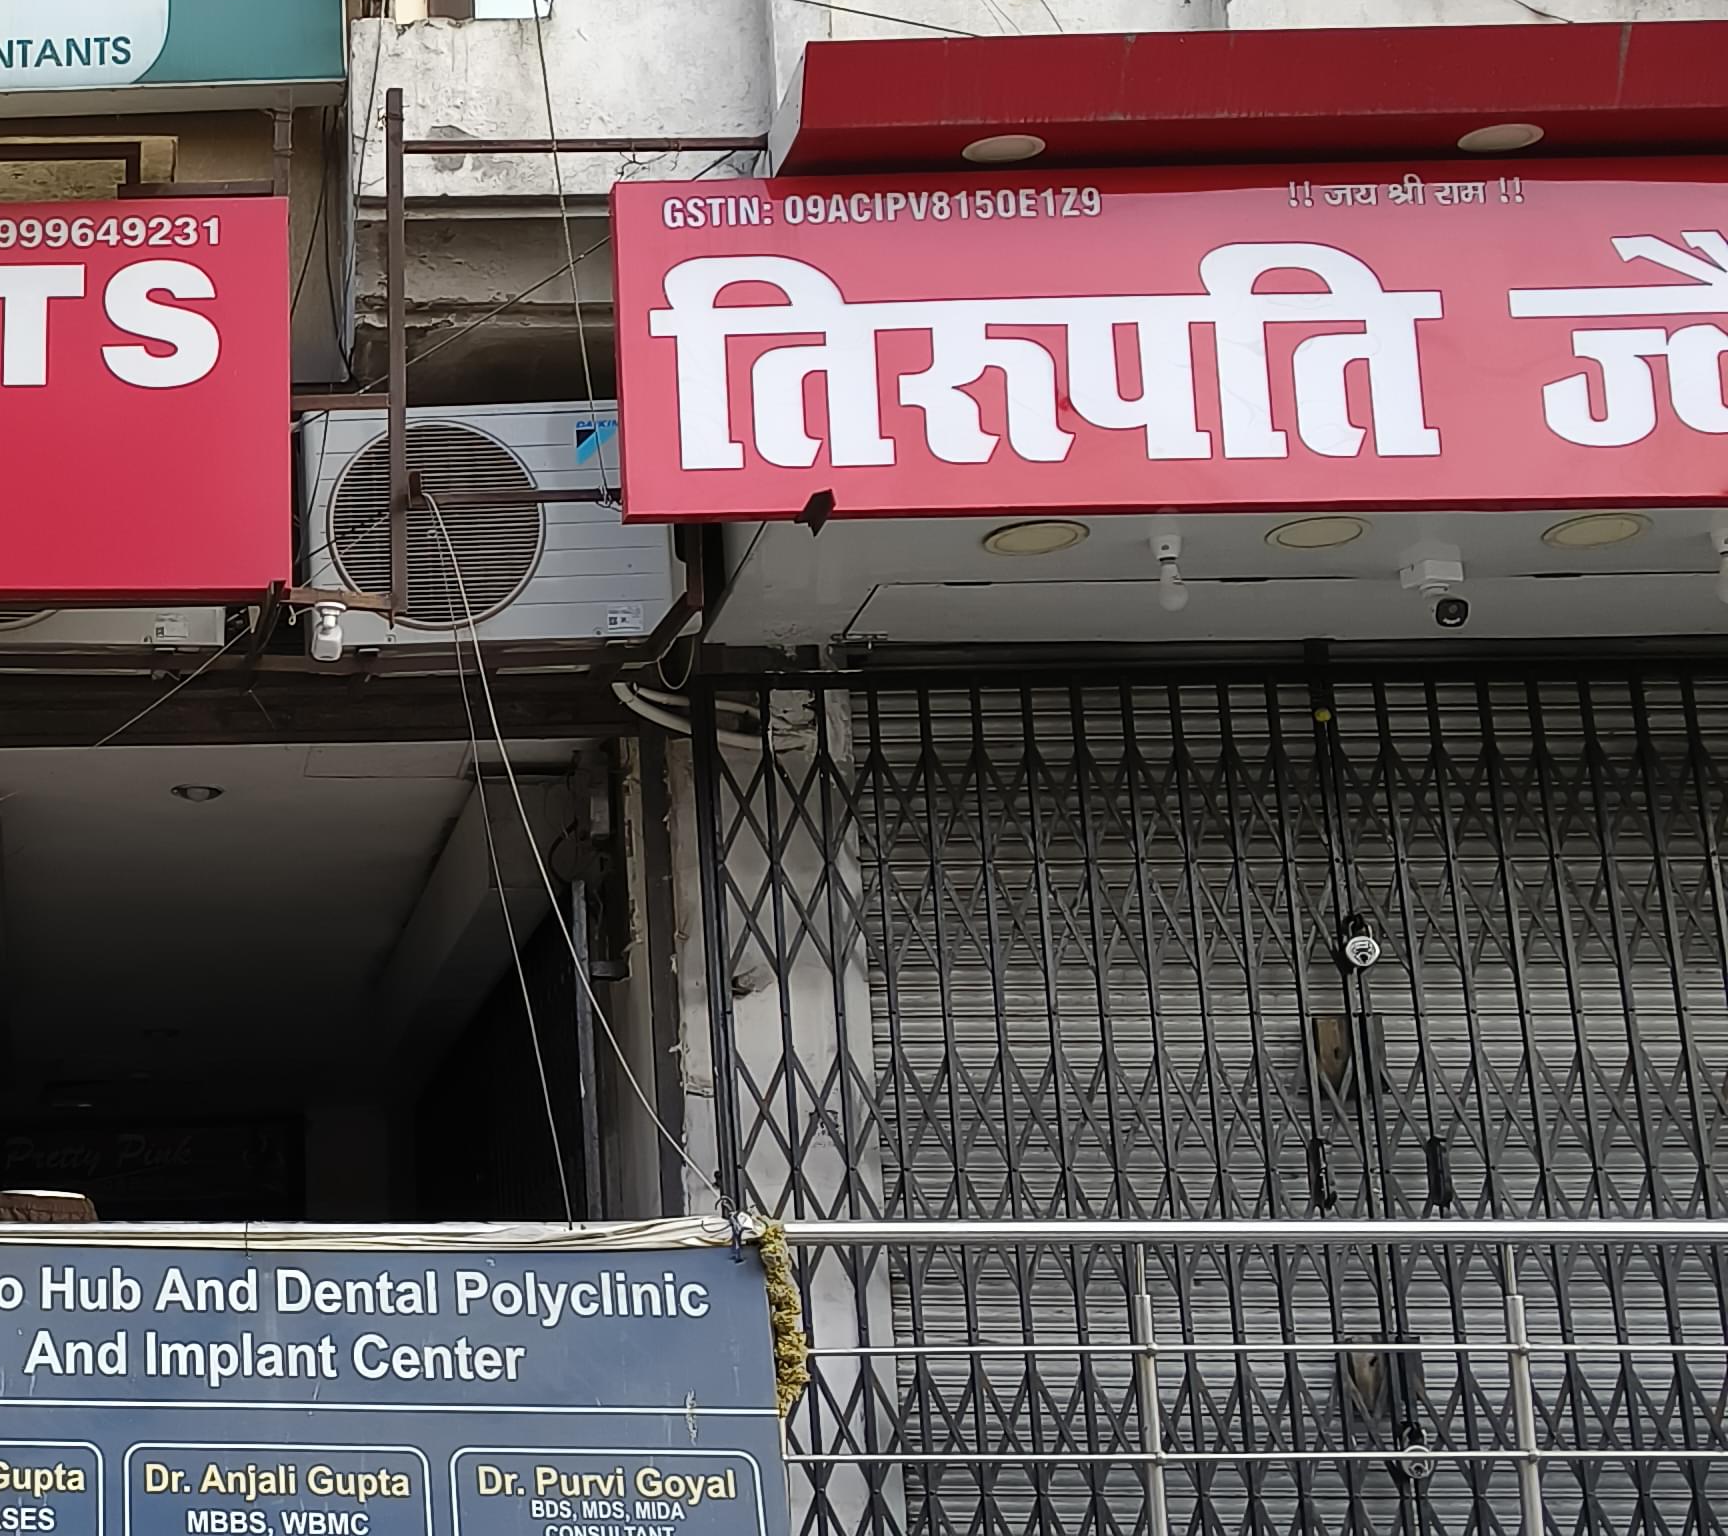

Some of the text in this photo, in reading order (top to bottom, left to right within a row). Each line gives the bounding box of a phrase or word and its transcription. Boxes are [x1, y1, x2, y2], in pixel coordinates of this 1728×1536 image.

[662, 187, 1101, 228] GSTIN: 09ACIPV8150E1Z9
[1319, 174, 1486, 206] जय श्री राम
[42, 1267, 140, 1310] Hub
[156, 1269, 257, 1311] And
[277, 1269, 436, 1313] Dental
[457, 1272, 708, 1326] Polyclinic
[146, 1464, 409, 1502] Dr. Anjali Gupta
[479, 1466, 735, 1504] Dr. Purvi Goyal
[188, 1511, 368, 1536] MBBS, WBMC
[532, 1500, 684, 1522] BDS, MDS, MIDA
